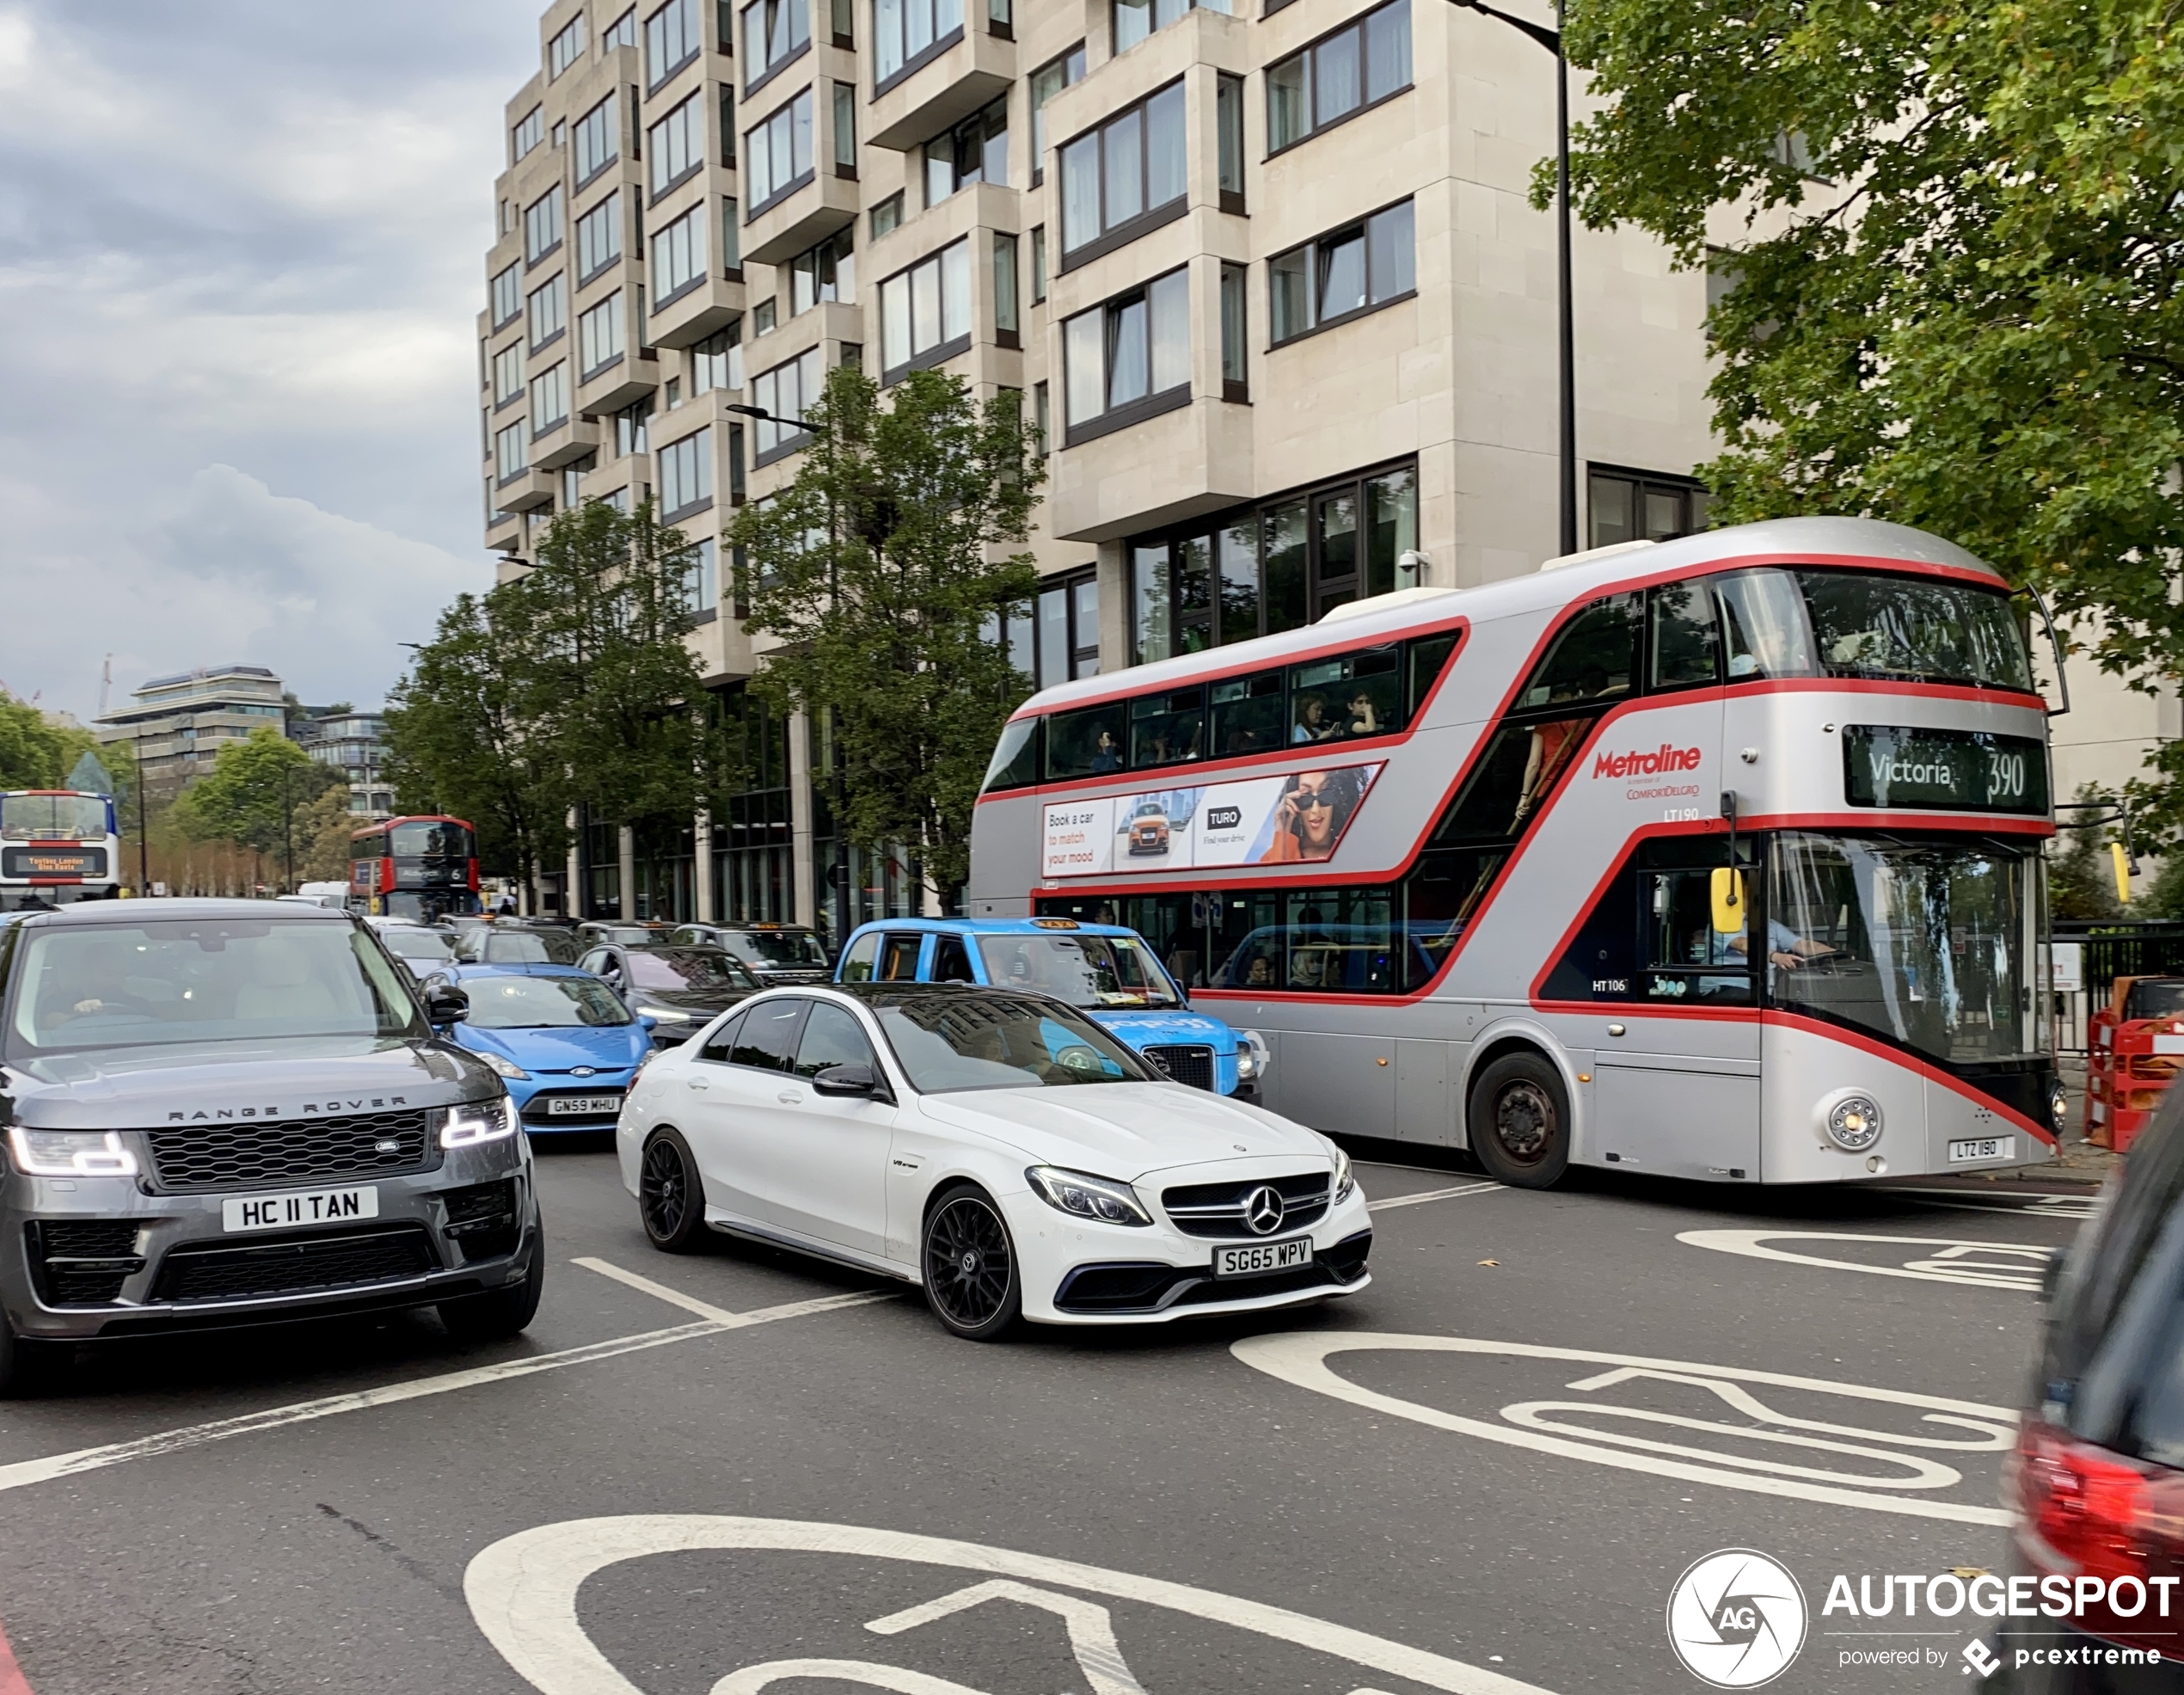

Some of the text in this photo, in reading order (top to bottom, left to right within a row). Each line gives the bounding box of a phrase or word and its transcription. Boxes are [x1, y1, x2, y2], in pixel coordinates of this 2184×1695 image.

[1592, 744, 1701, 779] Metroline
[1868, 752, 2025, 796] Victoria 390
[1050, 813, 1094, 826] Book a car
[1210, 811, 1238, 825] TURO
[1664, 808, 1699, 822] LT190
[1049, 830, 1085, 845] to match
[1204, 835, 1217, 844] Find
[1048, 849, 1094, 868] your mood
[451, 869, 461, 880] 6
[168, 1096, 407, 1121] RANGE ROVER
[555, 1098, 616, 1112] GN59 MHU
[1957, 1140, 1997, 1158] LTZ 1190
[308, 1192, 359, 1219] TAN
[1225, 1241, 1307, 1272] SG65 WPV
